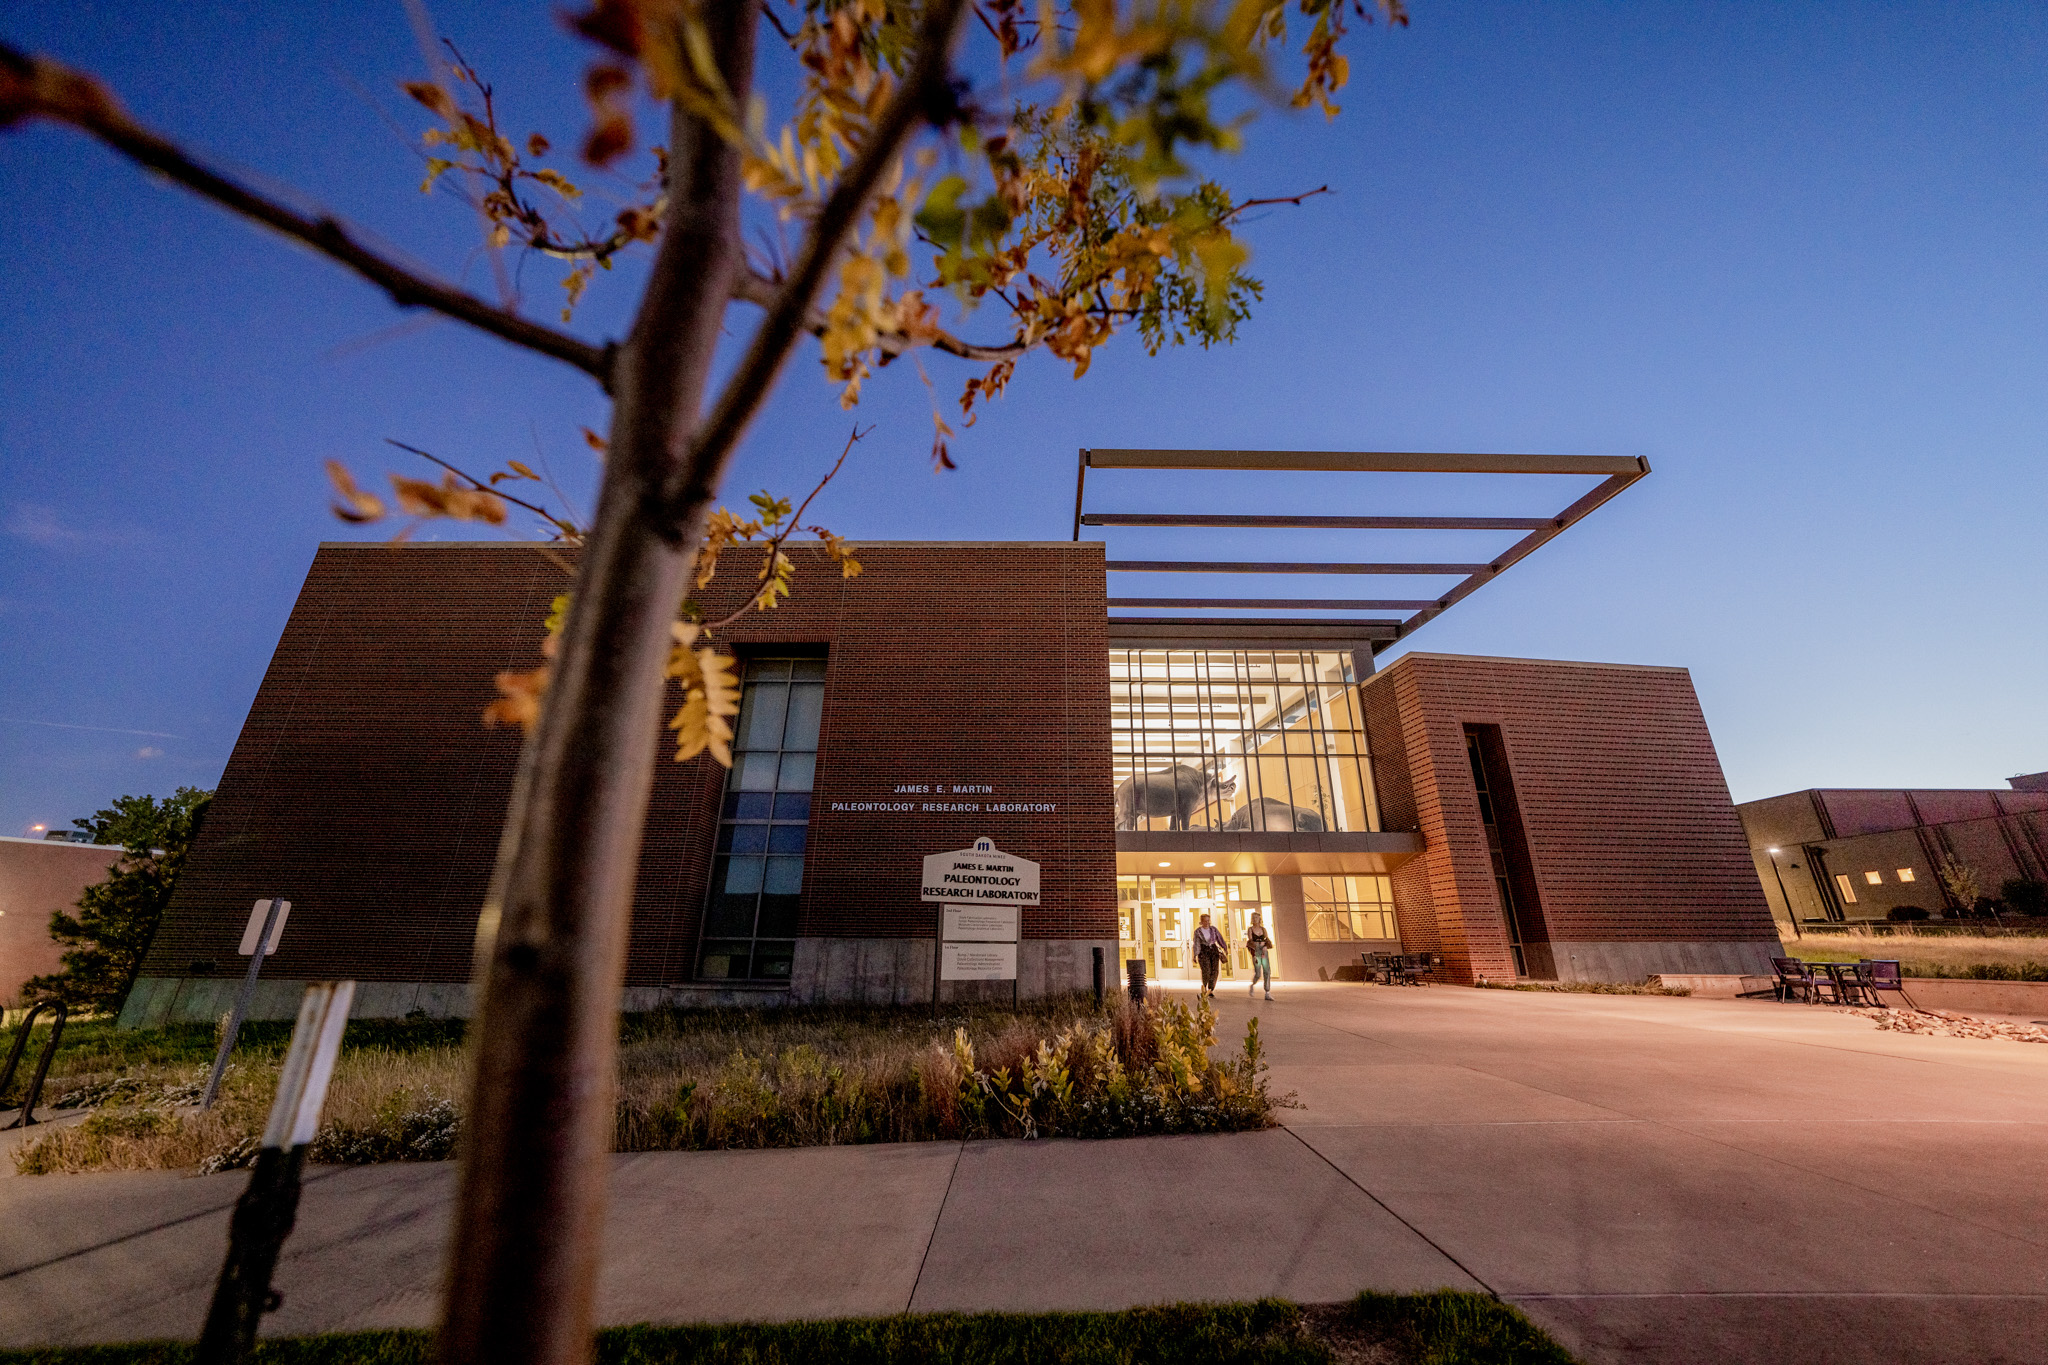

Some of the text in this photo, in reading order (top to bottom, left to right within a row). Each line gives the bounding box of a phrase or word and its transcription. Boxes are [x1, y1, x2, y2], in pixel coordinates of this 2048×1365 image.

[894, 784, 992, 794] JAMES E. MARTIN
[832, 802, 1056, 812] PALEONTOLOGY RESEARCH LABORATORY
[952, 862, 976, 870] JAMES
[986, 864, 1014, 872] MARTIN
[944, 874, 1020, 886] PALEONTOLOGY
[923, 886, 1039, 900] RESEARCH LABORATORY
